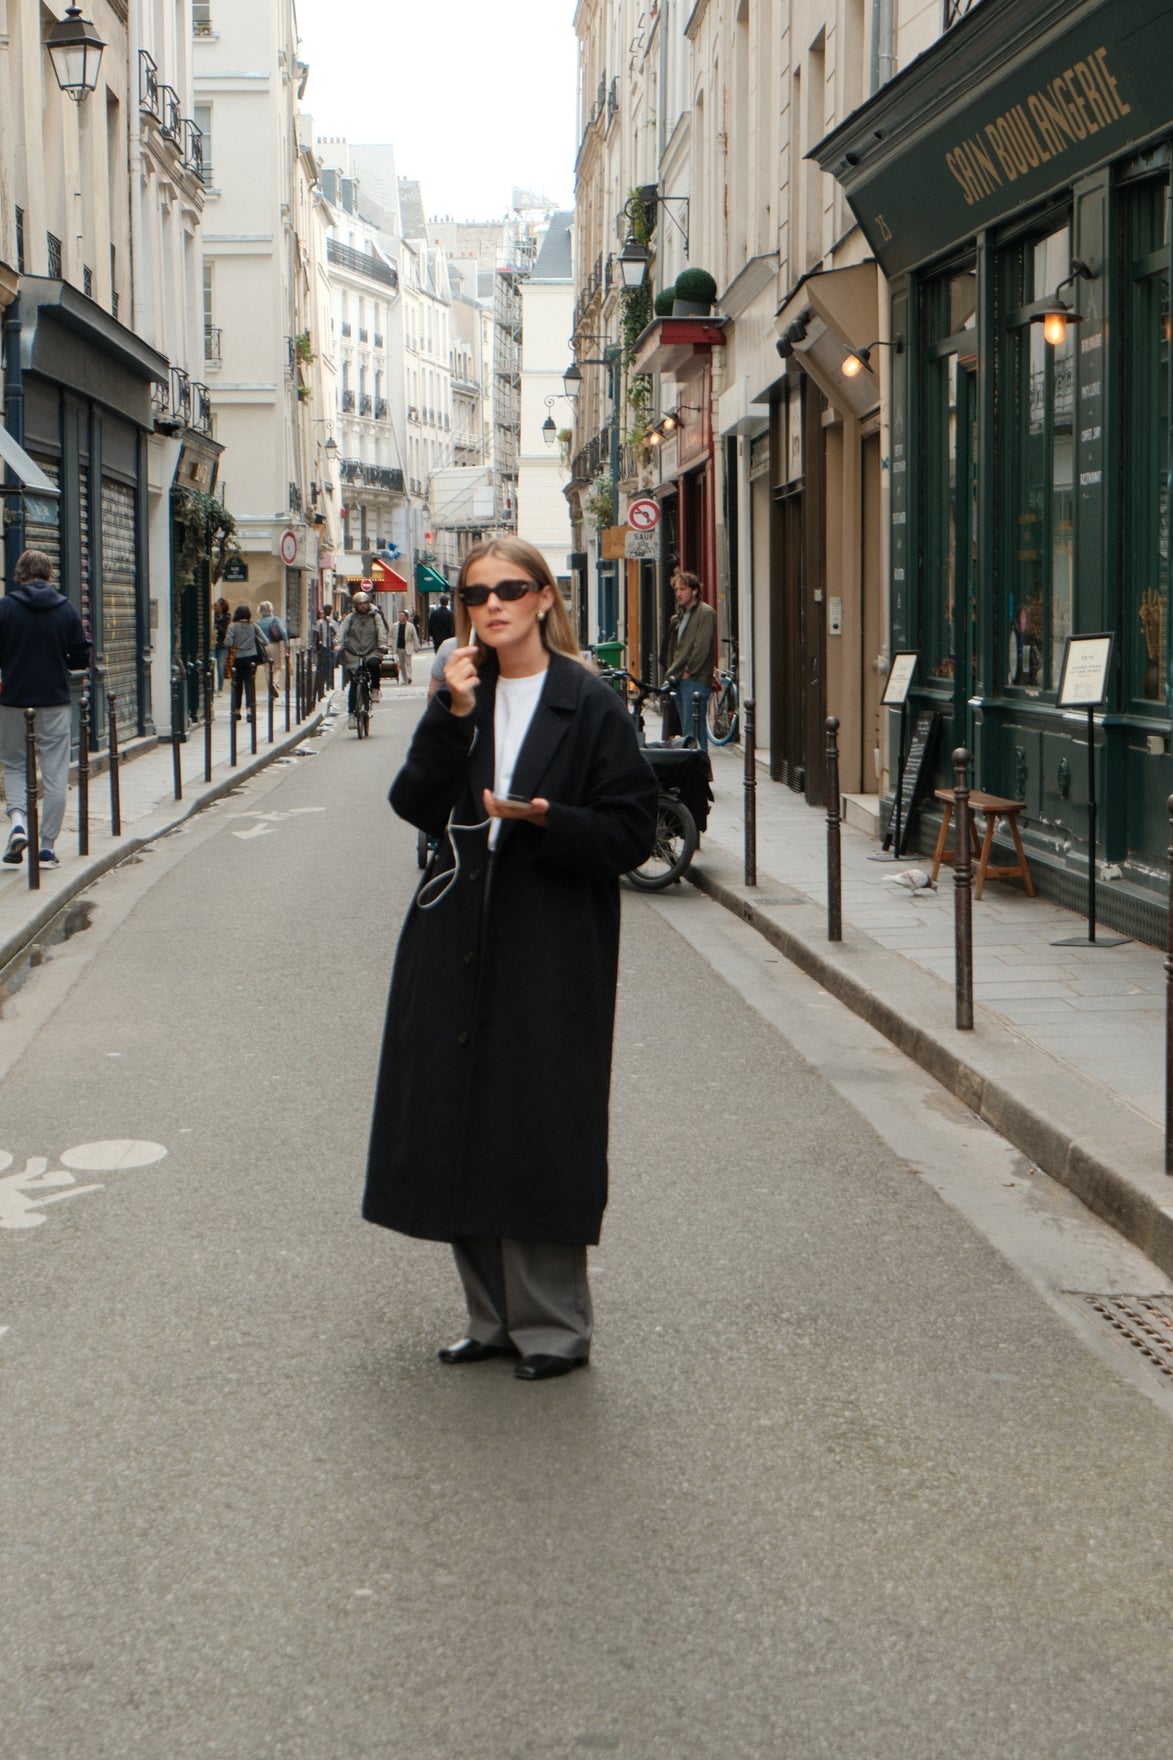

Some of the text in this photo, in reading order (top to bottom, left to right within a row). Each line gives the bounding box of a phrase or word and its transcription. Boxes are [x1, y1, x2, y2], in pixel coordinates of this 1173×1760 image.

[945, 46, 1131, 205] SAIN BOULANGERIE
[634, 533, 654, 541] SAUF
